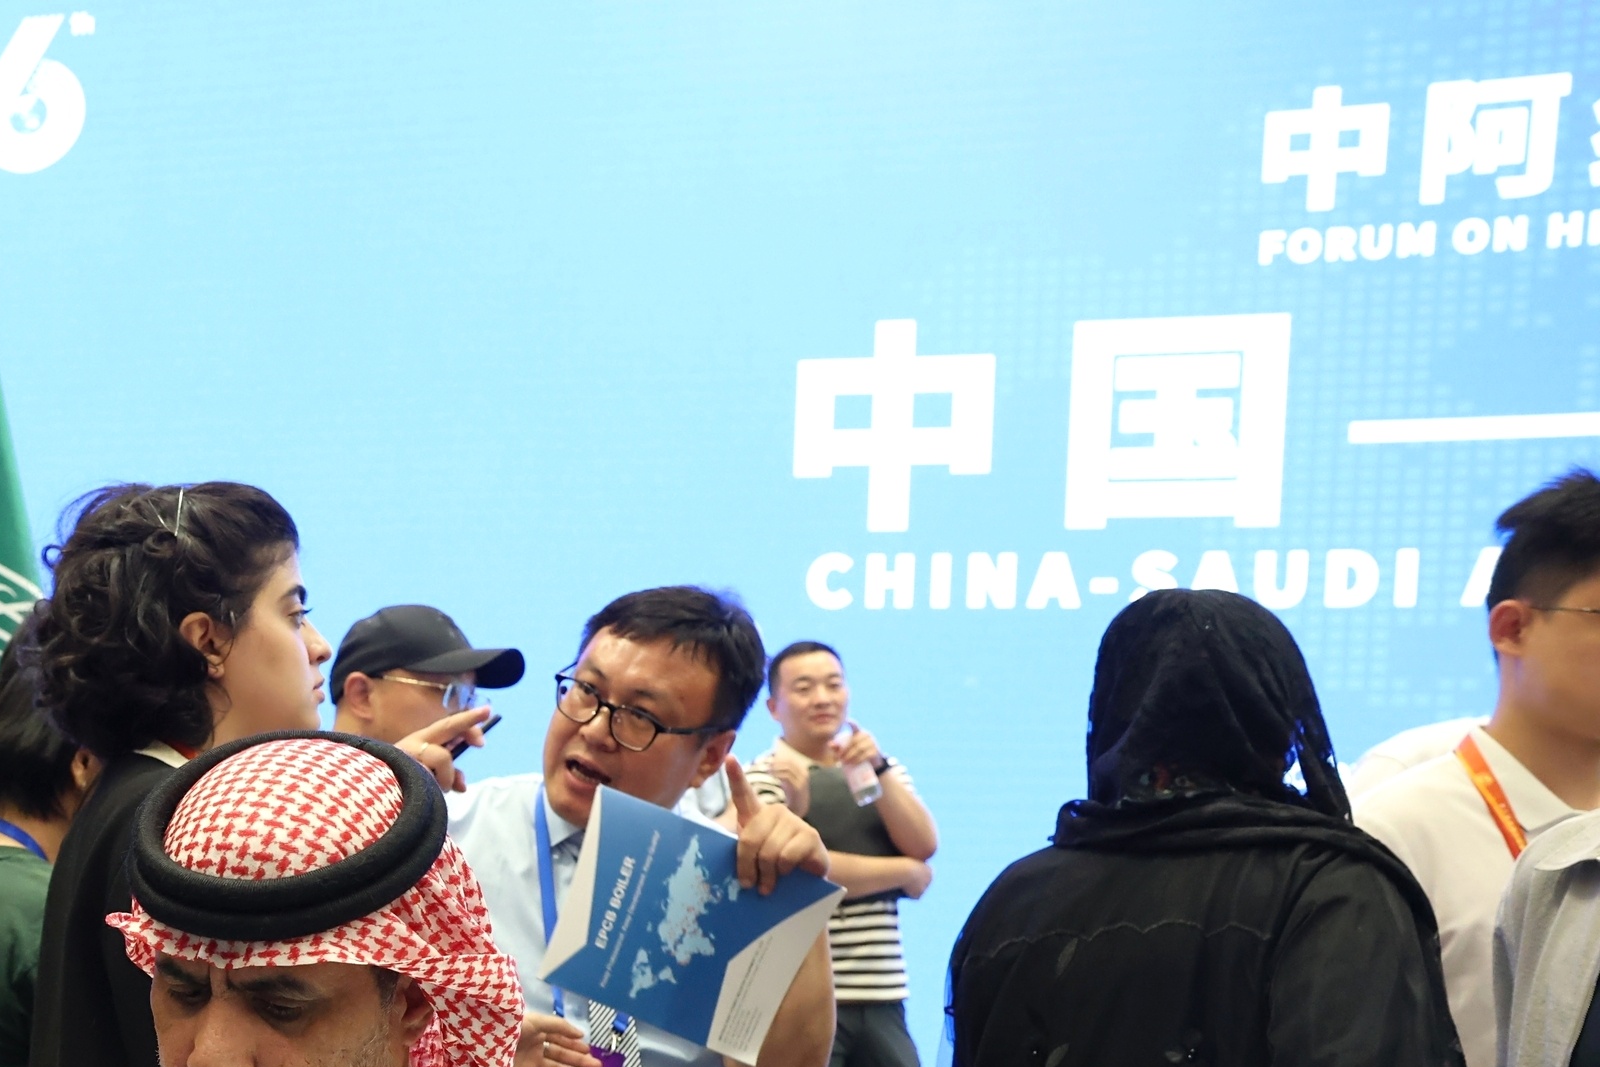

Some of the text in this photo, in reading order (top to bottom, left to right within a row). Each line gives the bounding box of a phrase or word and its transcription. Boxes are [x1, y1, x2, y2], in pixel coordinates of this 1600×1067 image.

[1261, 72, 1600, 211] 中阿
[1258, 220, 1436, 265] FORUM
[1451, 214, 1529, 255] ON
[804, 548, 1421, 610] CHINA-SAUDI
[595, 856, 636, 949] EPCB BOILER
